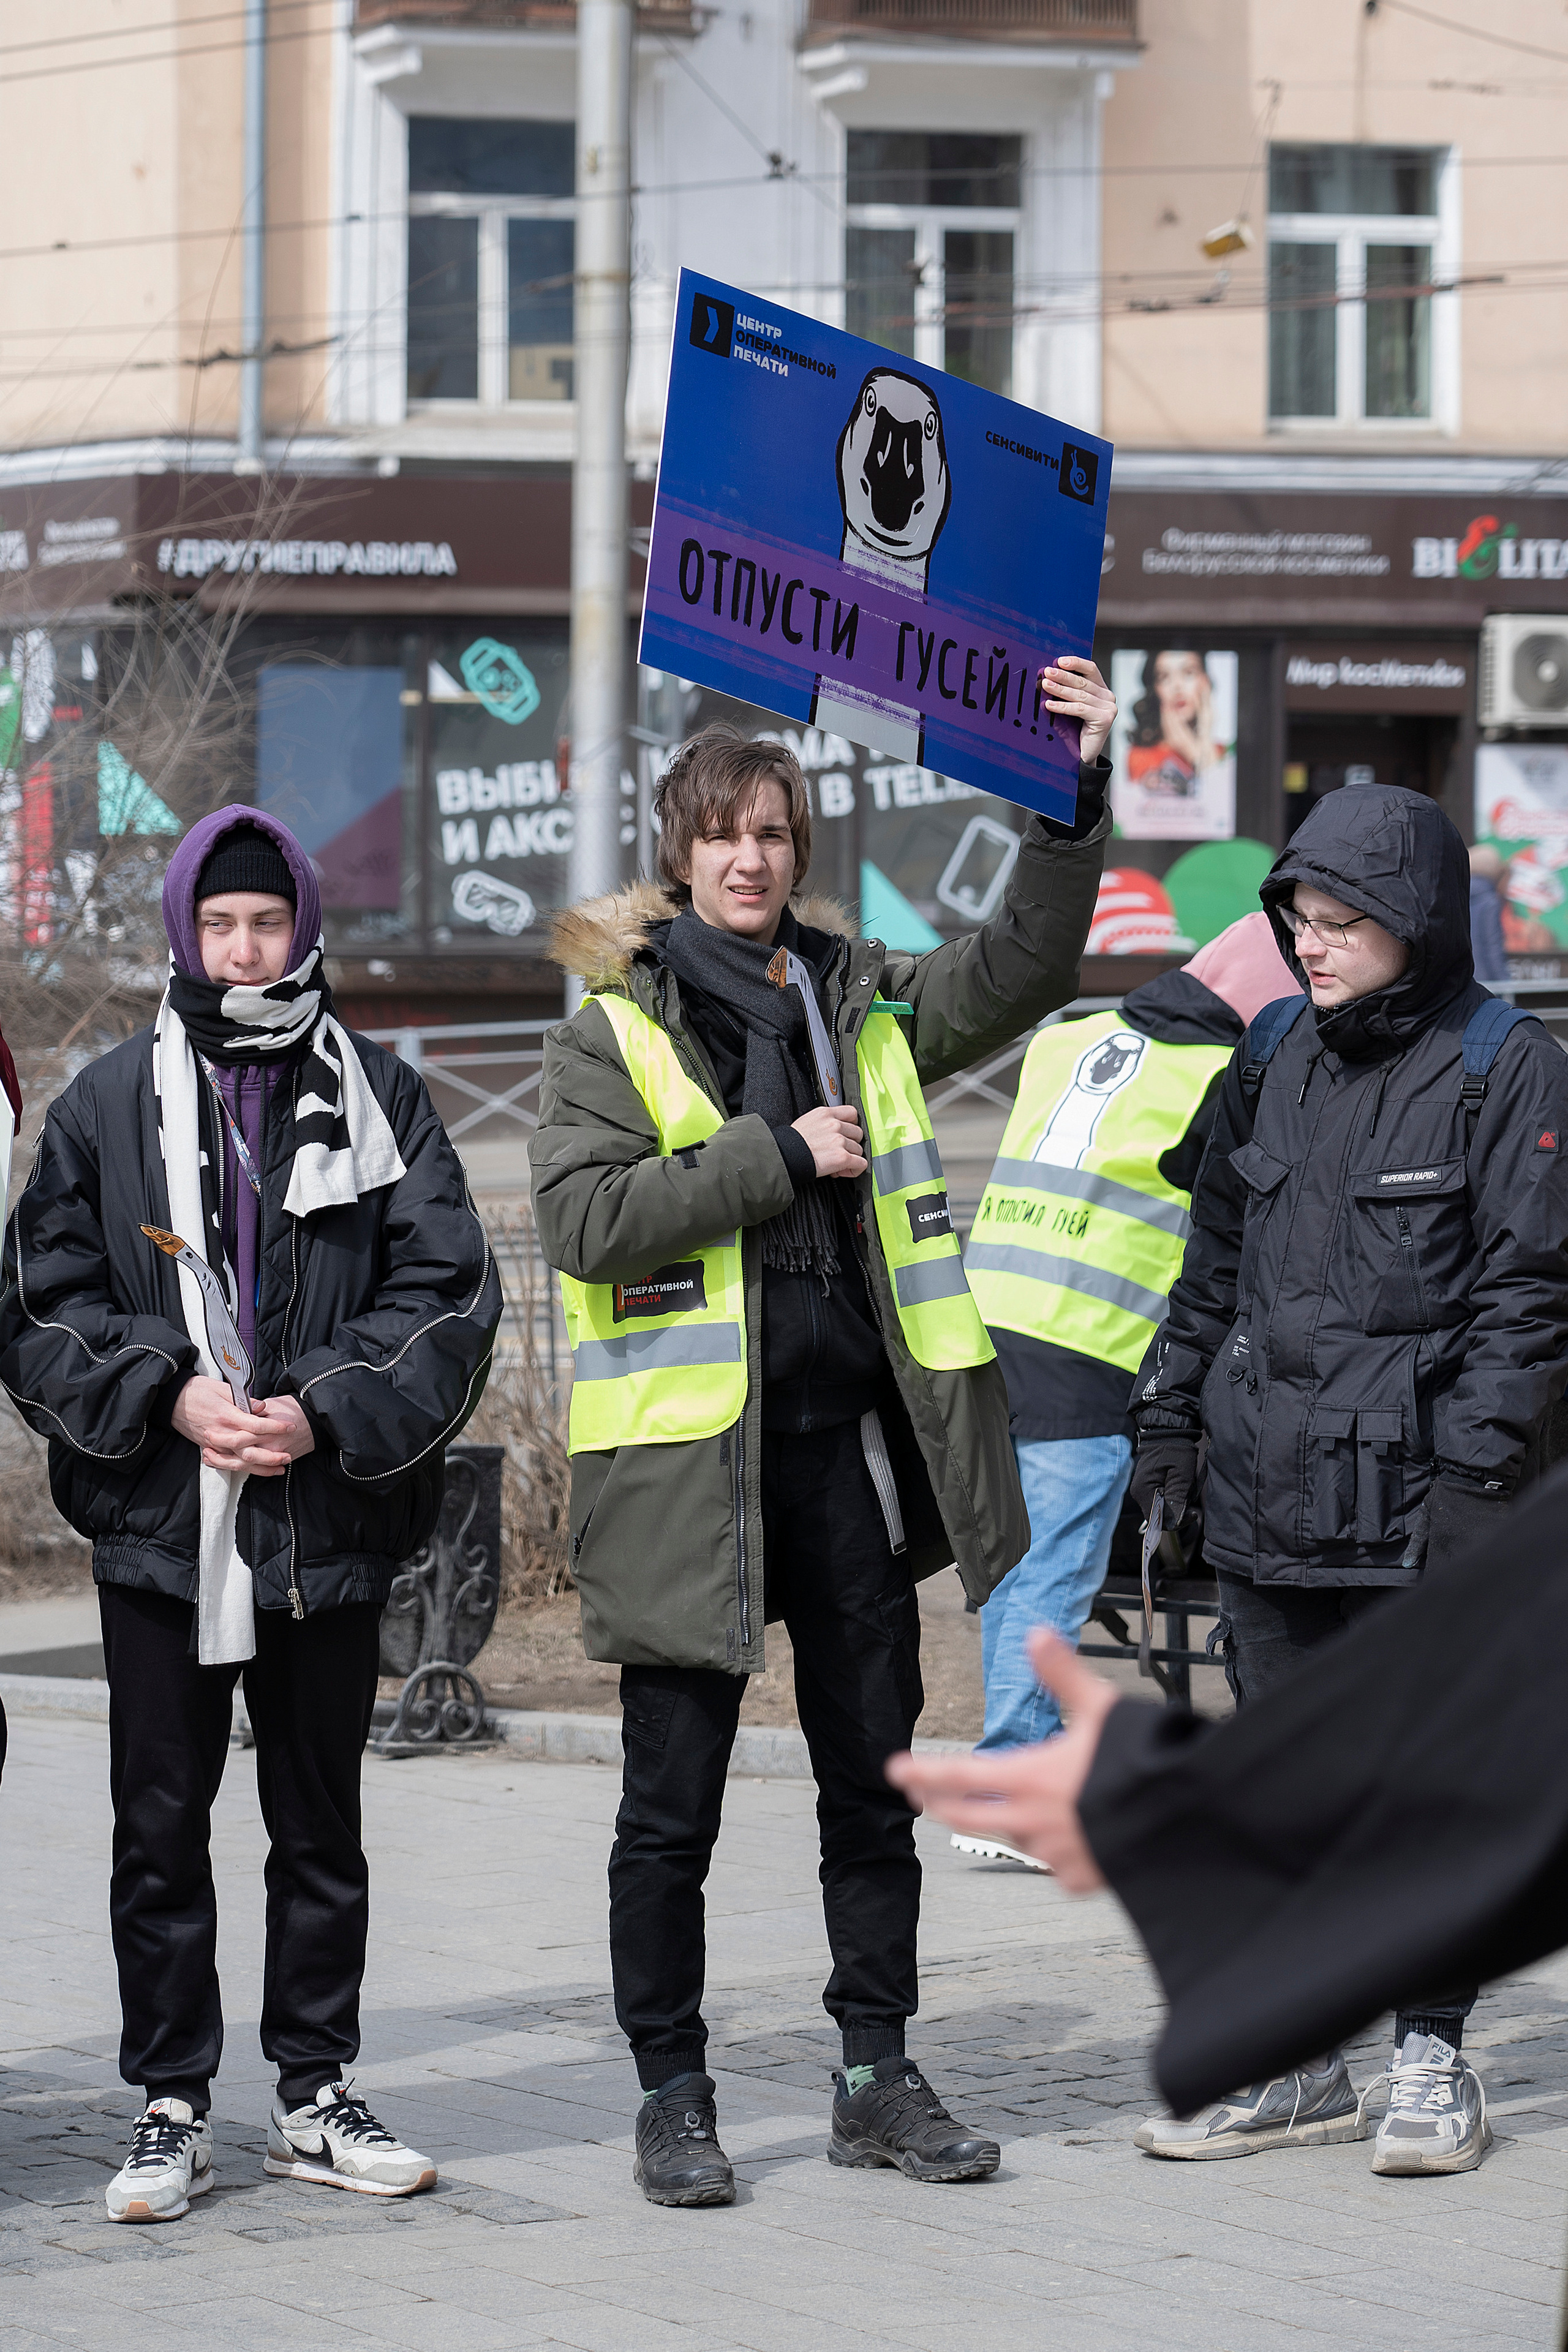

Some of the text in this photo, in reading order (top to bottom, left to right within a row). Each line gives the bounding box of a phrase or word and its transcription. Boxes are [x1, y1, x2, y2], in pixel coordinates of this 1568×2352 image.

[737, 313, 782, 339] ЦЕНТР
[734, 345, 788, 377] ПЕЧАТИ
[736, 330, 837, 380] ОПЕРАТИВНОЙ
[986, 431, 1059, 470] СЕНСИВИТИ
[679, 538, 859, 661] ОТПУСТИ
[1381, 1172, 1414, 1183] SUPERIOR
[982, 1197, 991, 1221] Я
[624, 1279, 693, 1297] ОПЕРАТИВНОЙ
[1431, 2041, 1451, 2059] FILA
